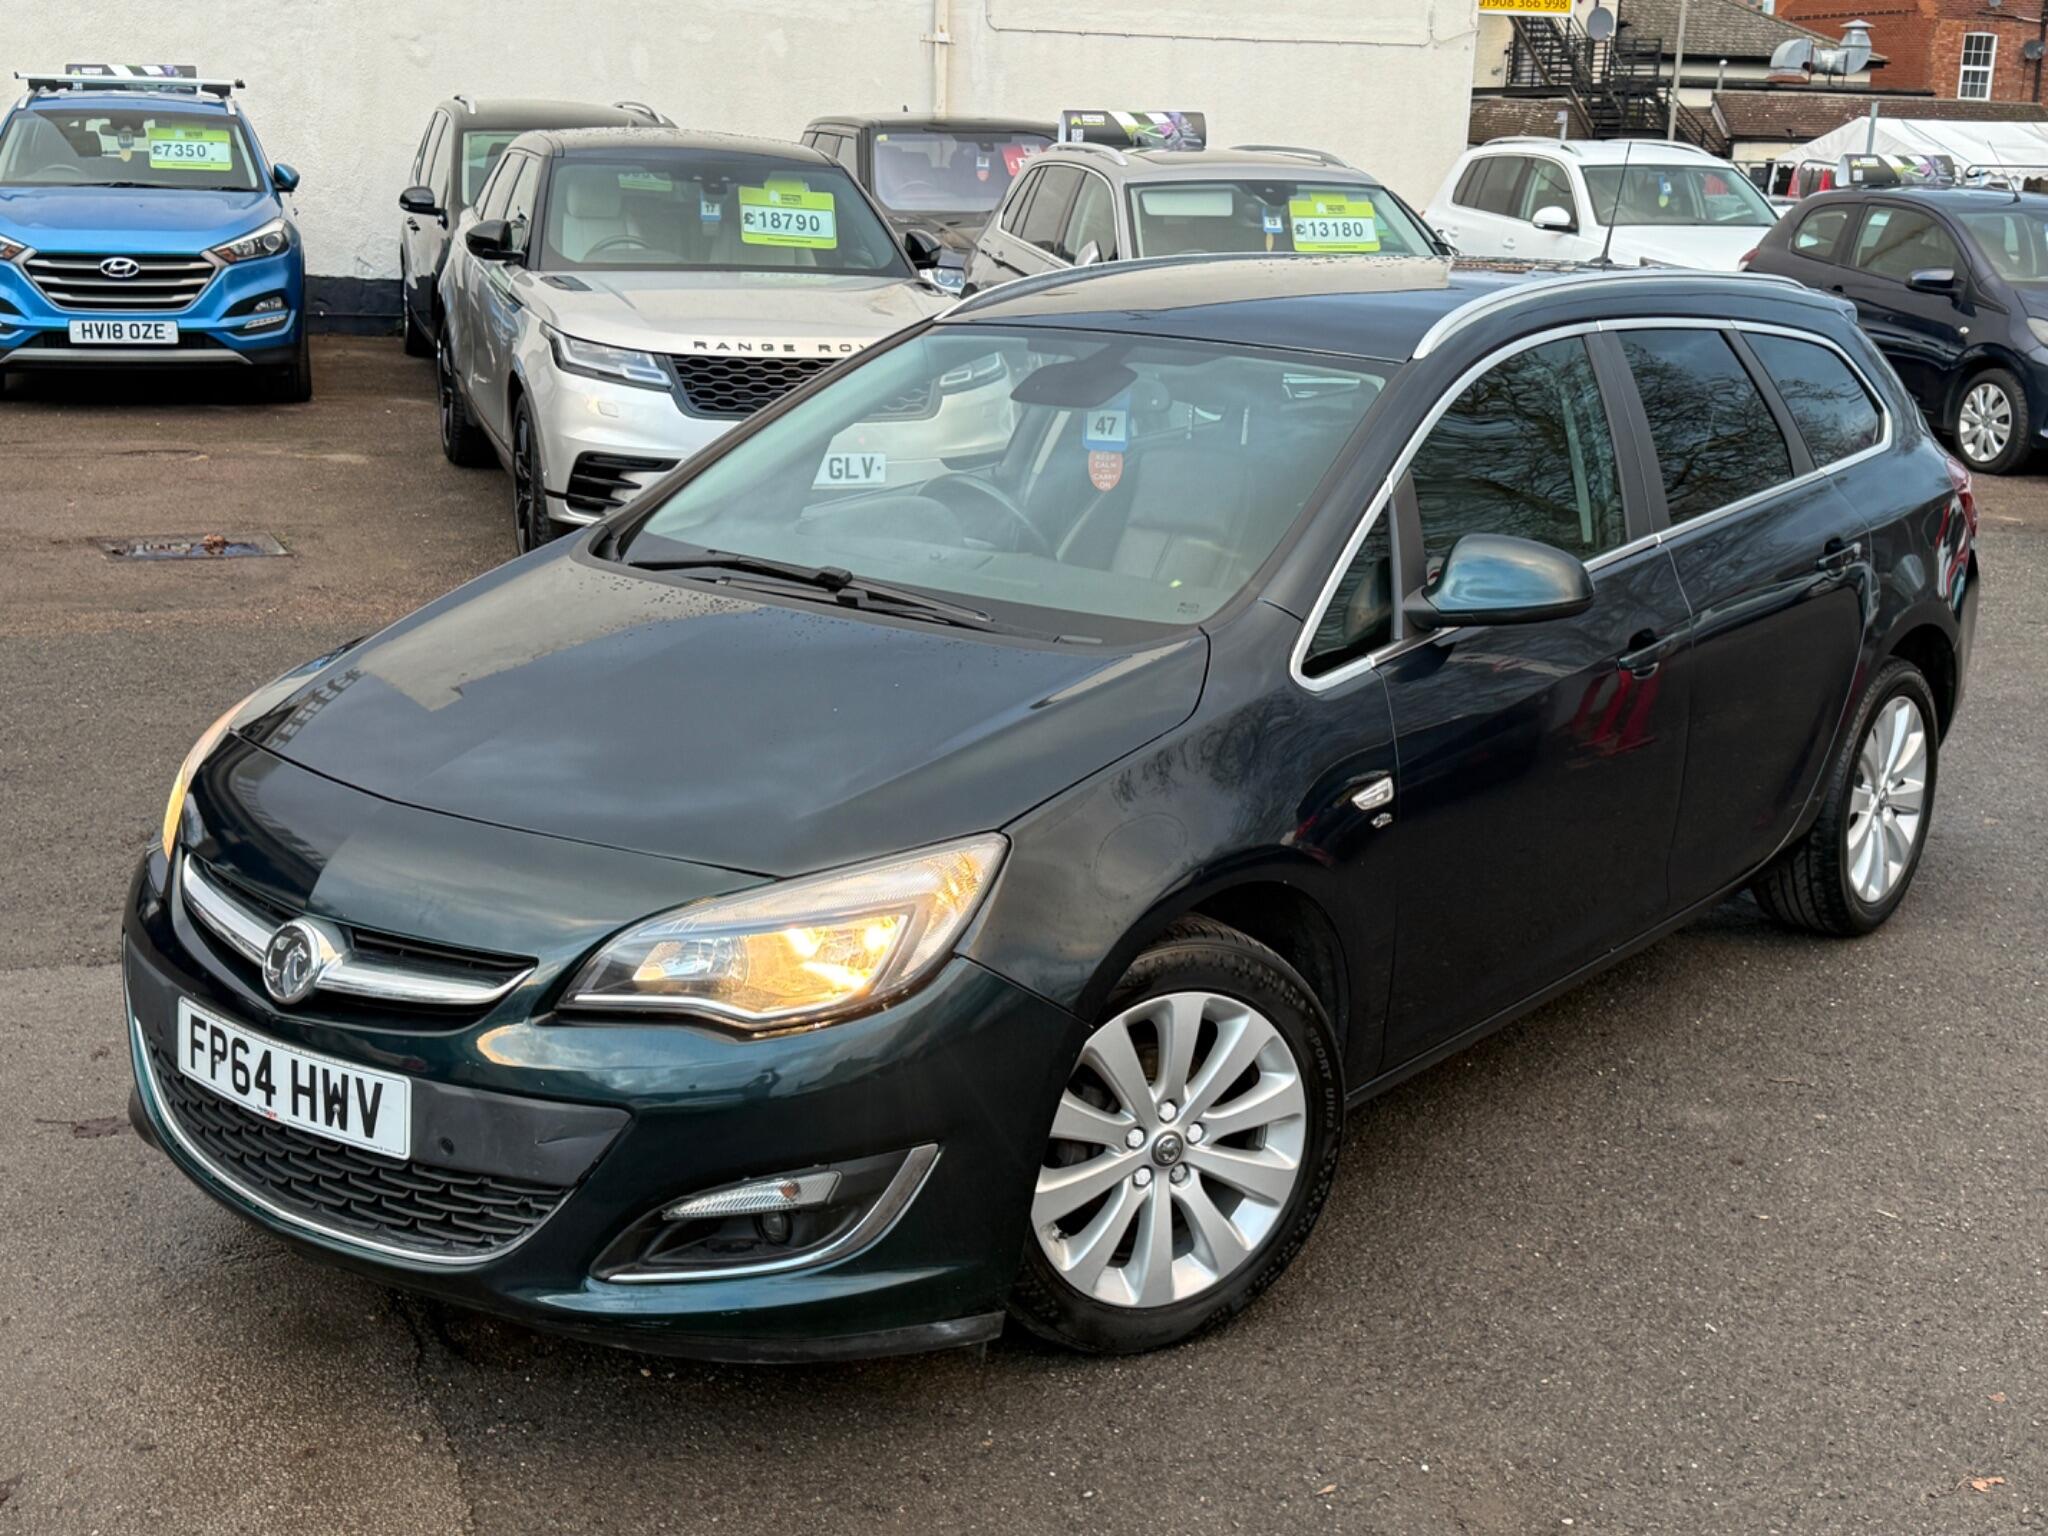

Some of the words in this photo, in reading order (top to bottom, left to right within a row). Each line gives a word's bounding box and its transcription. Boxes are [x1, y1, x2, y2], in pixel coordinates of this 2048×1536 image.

[1544, 0, 1567, 9] 998
[153, 144, 206, 158] £7350
[743, 211, 820, 232] £18790
[1295, 222, 1363, 237] £13180
[81, 322, 124, 340] HV18
[129, 323, 166, 340] OZE
[693, 341, 796, 352] RANGE
[1095, 416, 1117, 436] 47
[829, 457, 874, 480] GLV
[190, 1013, 277, 1108] FP64
[291, 1058, 384, 1140] HWV
